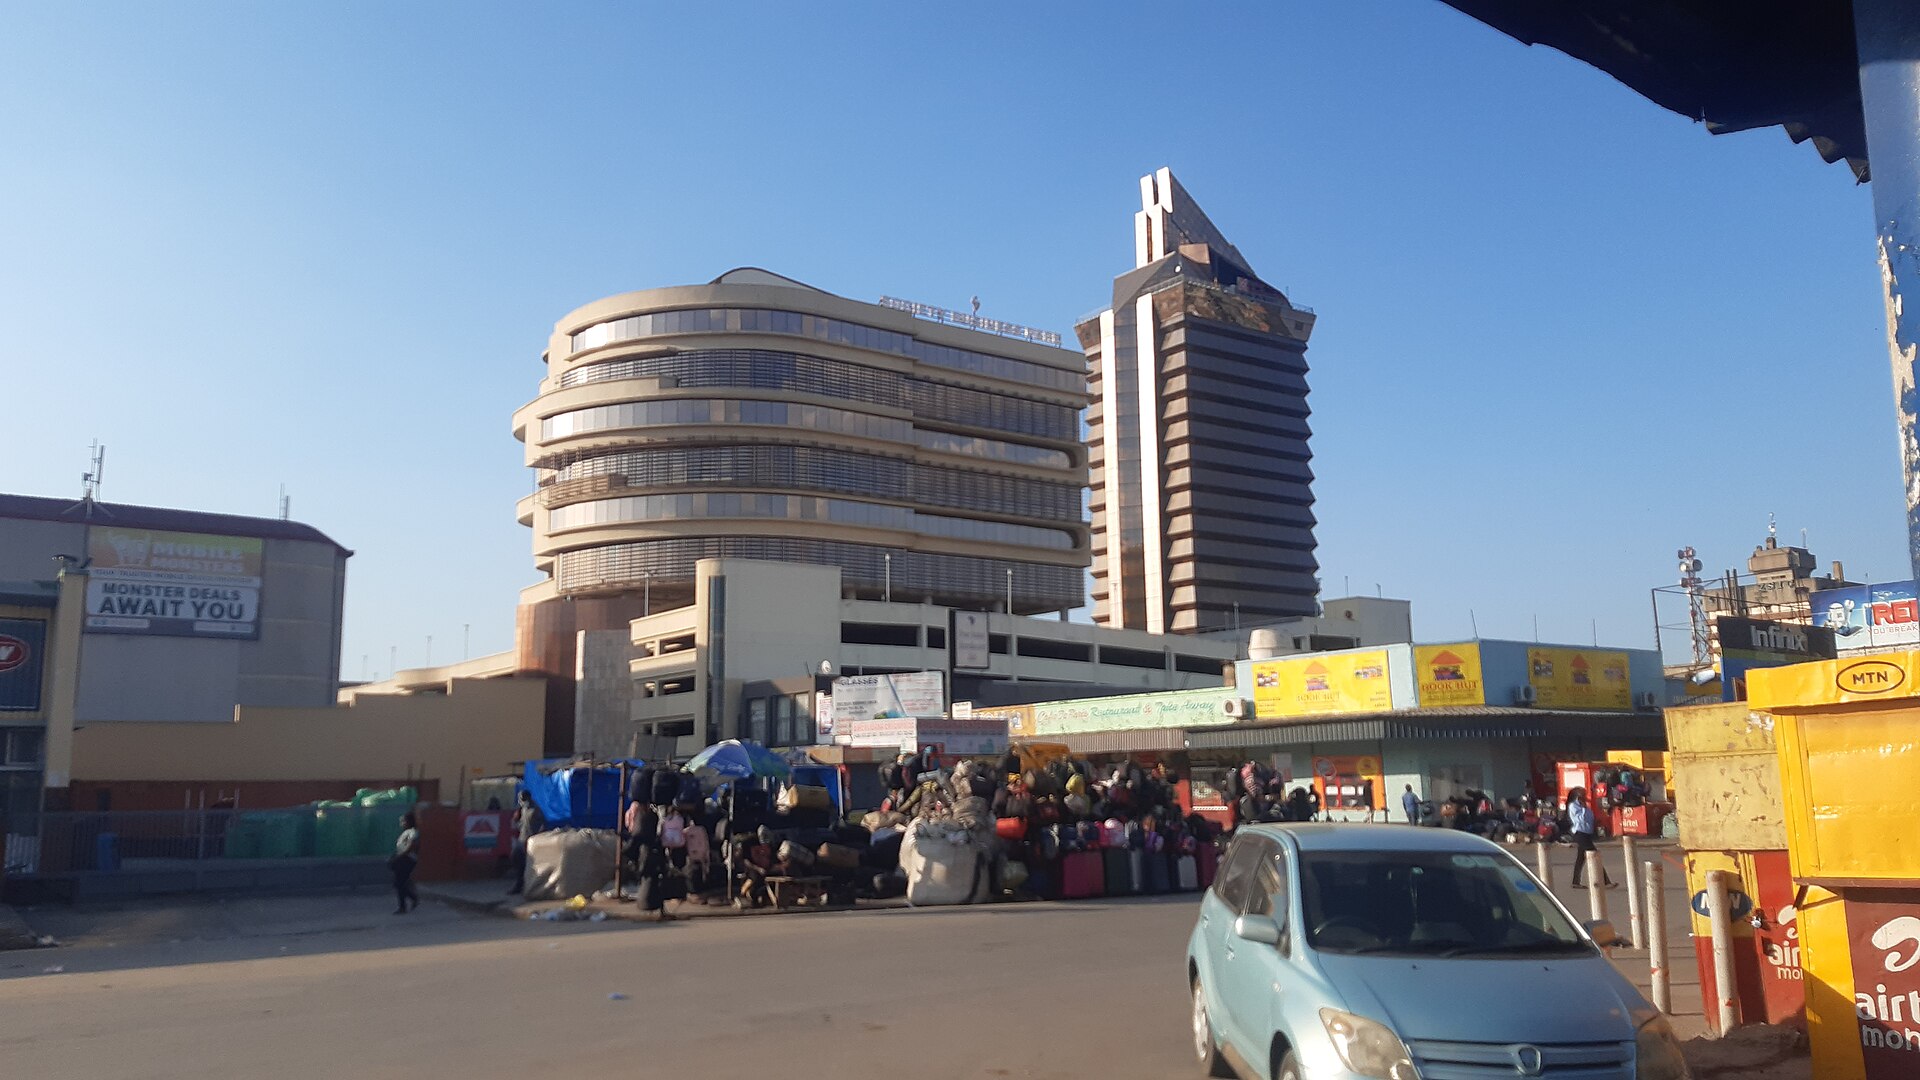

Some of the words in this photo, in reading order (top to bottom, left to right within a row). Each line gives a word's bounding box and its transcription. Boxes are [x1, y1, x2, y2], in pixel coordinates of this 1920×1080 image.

[102, 582, 185, 598] MONSTER
[189, 587, 241, 601] DEALS
[99, 596, 184, 617] AWAIT
[191, 601, 244, 620] YOU
[1422, 681, 1452, 691] BOOK
[1455, 679, 1478, 690] HUT
[1852, 670, 1889, 685] MTN
[1090, 703, 1141, 717] Restaurant
[1154, 701, 1177, 715] Take
[1181, 700, 1215, 713] Away
[1700, 892, 1742, 910] MN
